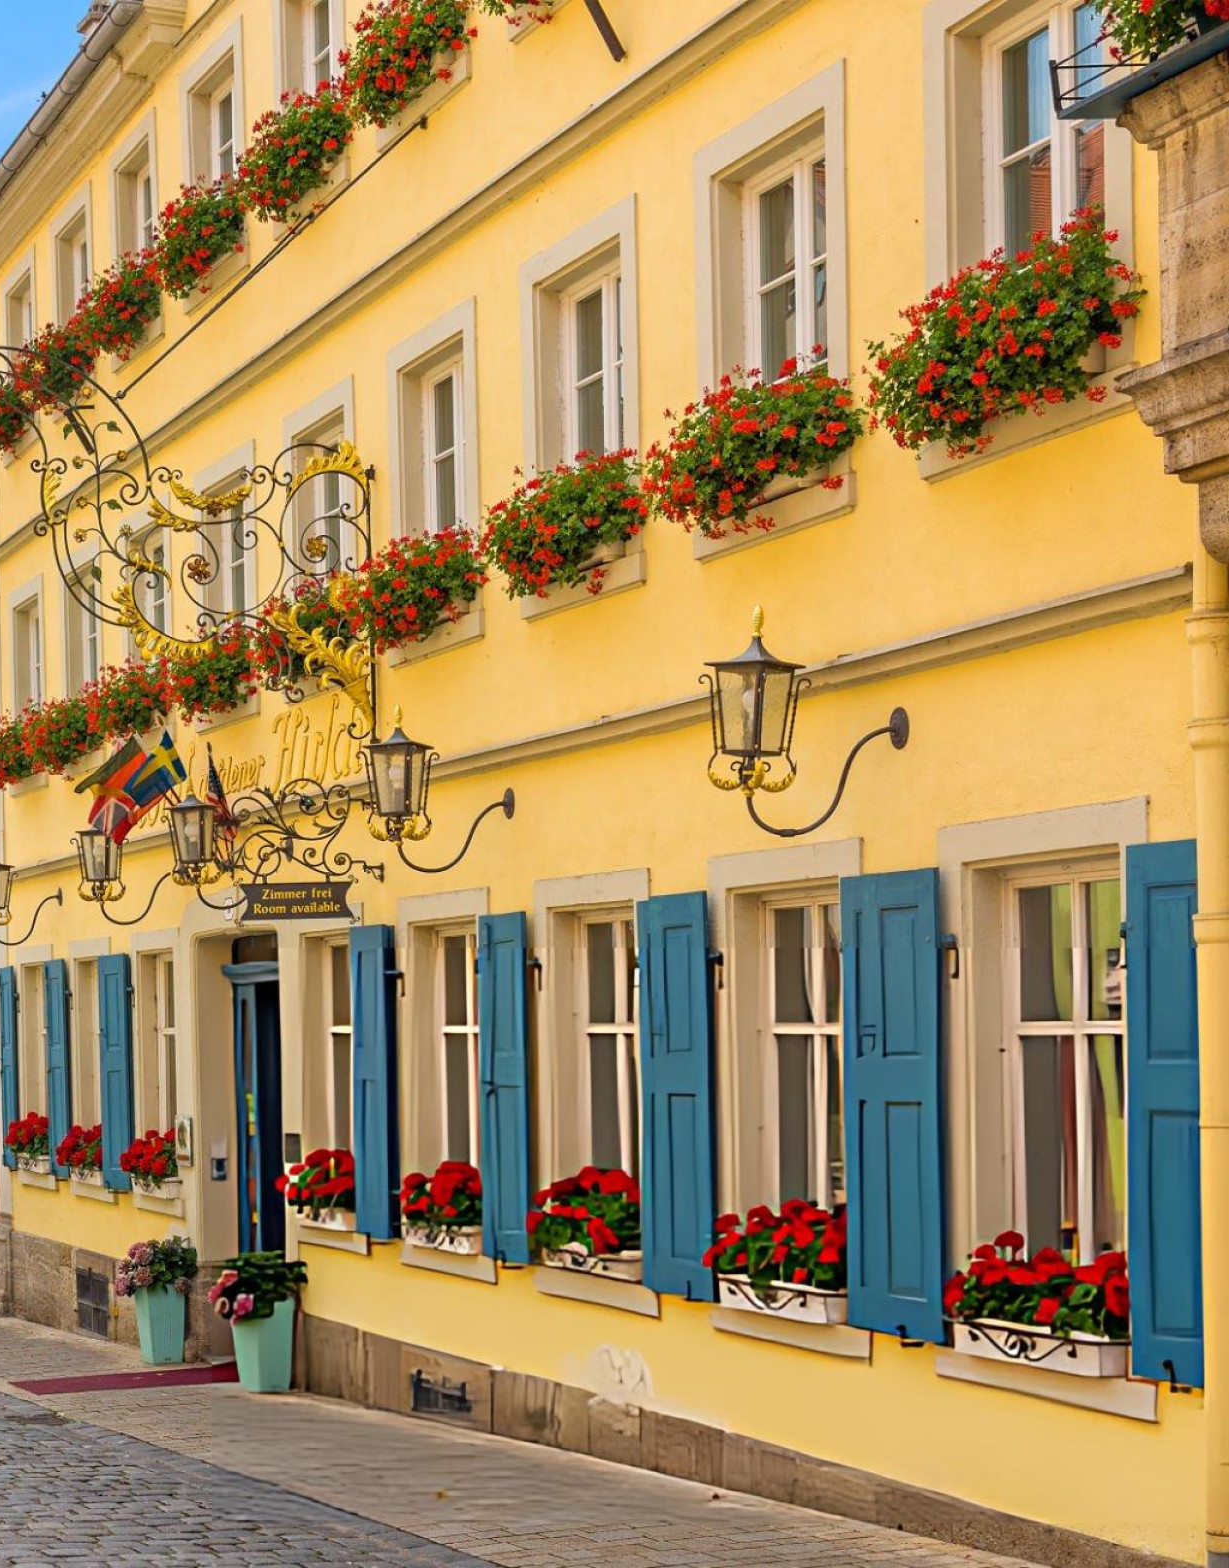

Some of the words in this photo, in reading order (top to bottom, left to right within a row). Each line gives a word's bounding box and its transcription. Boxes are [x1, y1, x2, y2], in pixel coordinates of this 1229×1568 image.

[261, 888, 307, 900] Zimmer
[311, 887, 333, 899] frei
[253, 903, 287, 915] Room
[291, 901, 342, 913] available
